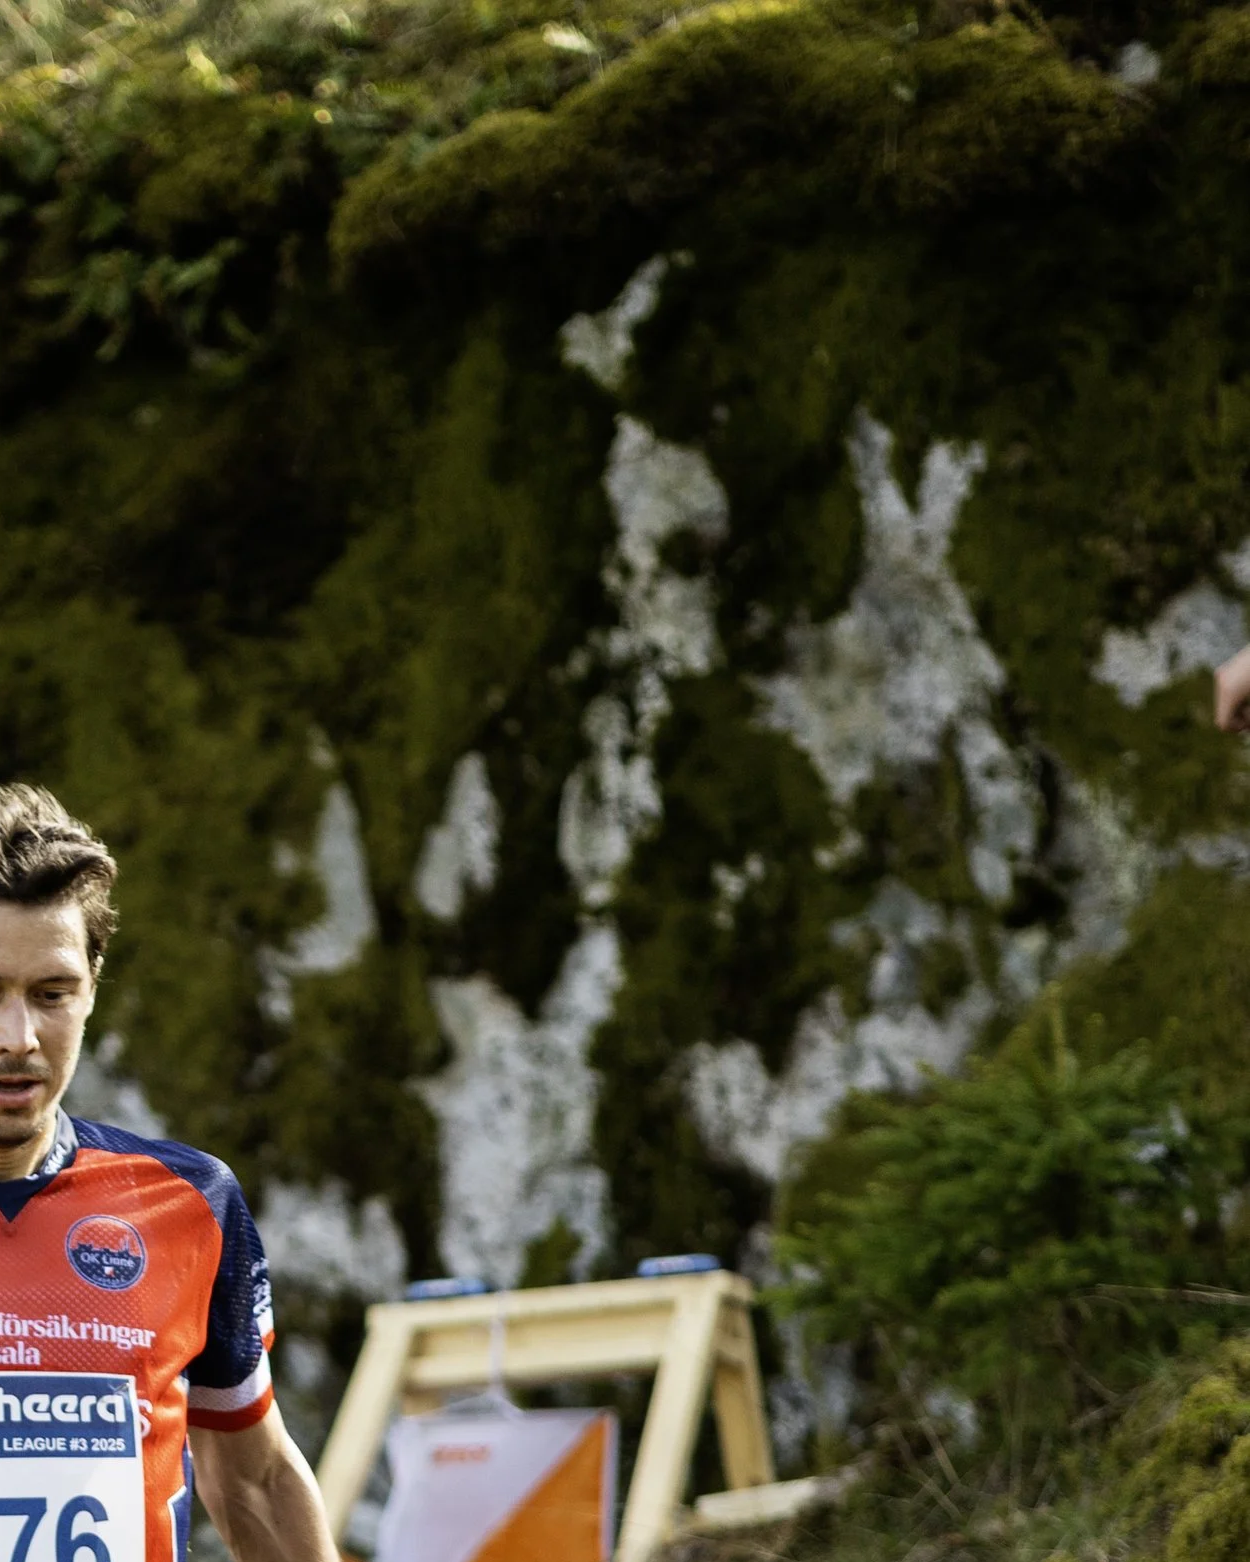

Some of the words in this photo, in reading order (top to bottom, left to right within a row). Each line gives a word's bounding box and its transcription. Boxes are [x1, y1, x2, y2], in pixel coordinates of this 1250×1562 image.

[80, 1251, 100, 1264] OK
[4, 1438, 66, 1451] LEAGUE
[70, 1438, 87, 1451] #3
[91, 1438, 125, 1451] 2025
